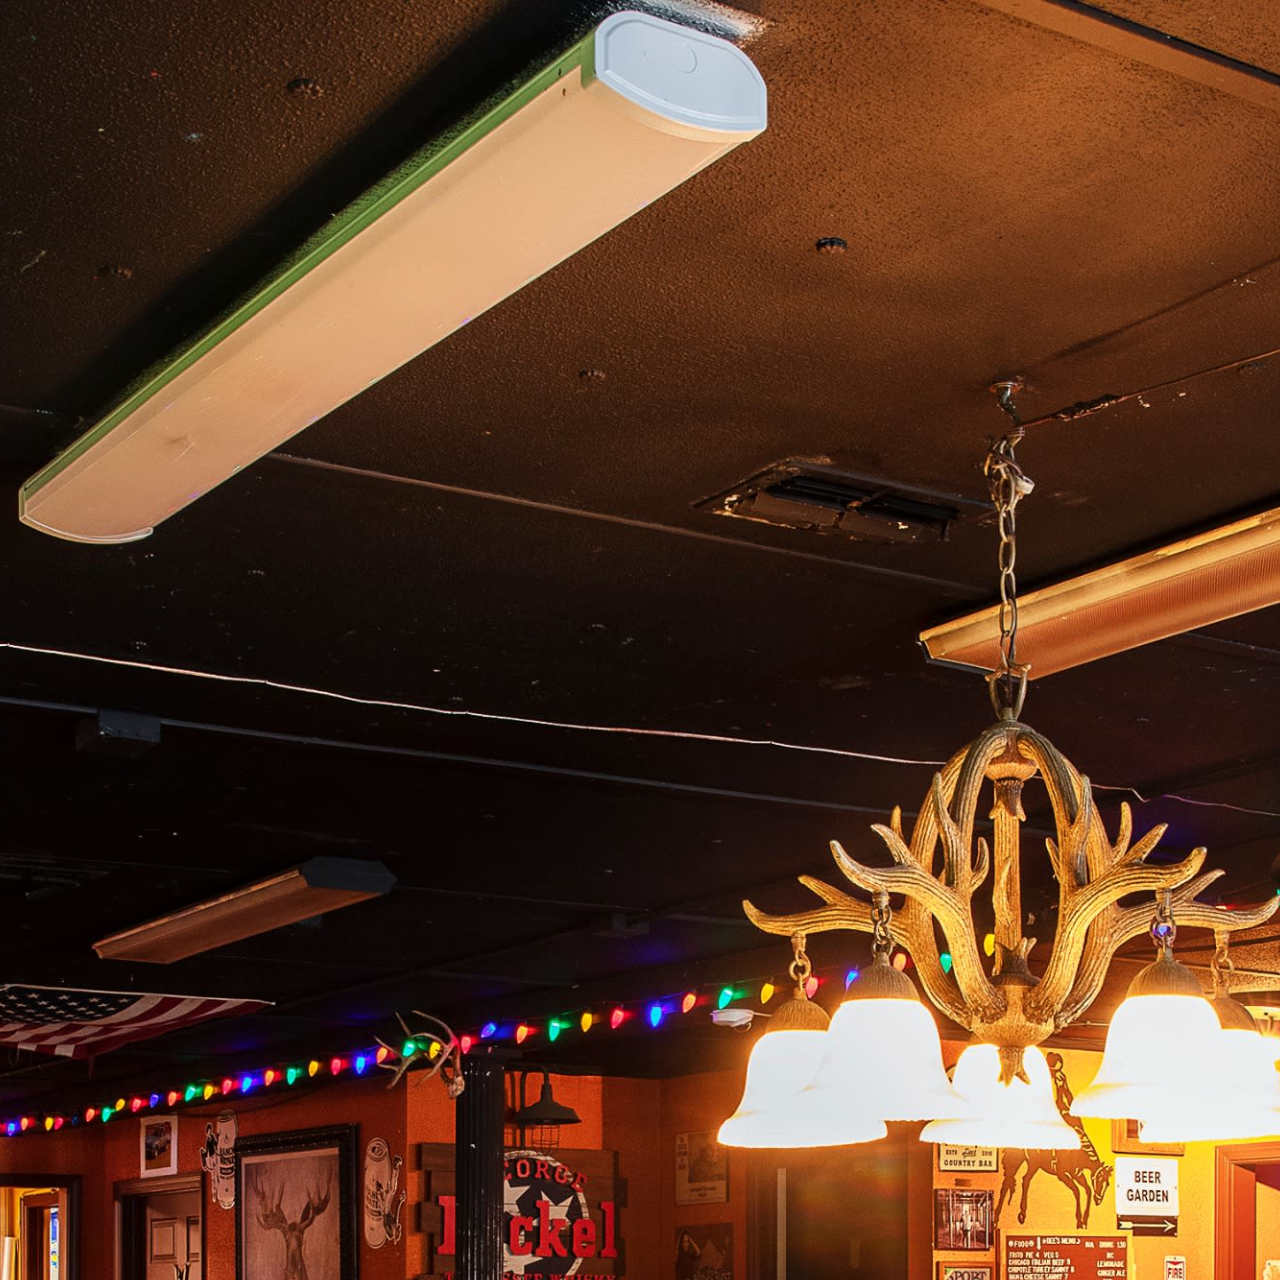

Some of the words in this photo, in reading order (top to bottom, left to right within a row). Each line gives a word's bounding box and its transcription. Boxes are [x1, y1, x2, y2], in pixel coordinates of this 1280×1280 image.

[1134, 1171, 1161, 1184] BEER
[1127, 1189, 1169, 1203] GARDEN
[1168, 1268, 1183, 1279] FIRE
